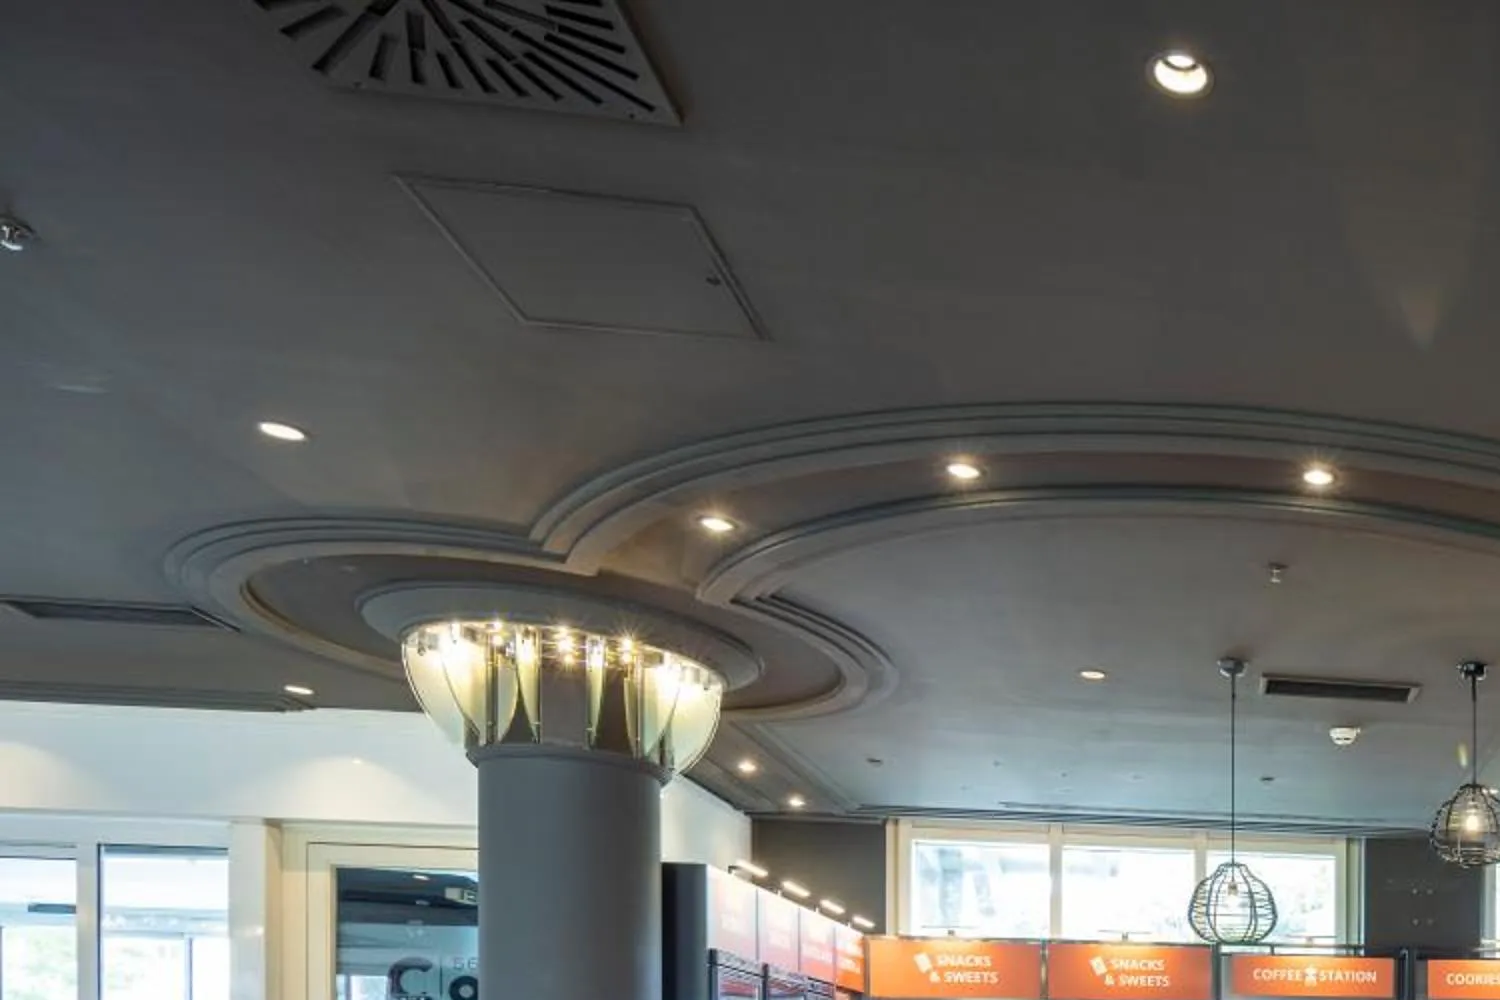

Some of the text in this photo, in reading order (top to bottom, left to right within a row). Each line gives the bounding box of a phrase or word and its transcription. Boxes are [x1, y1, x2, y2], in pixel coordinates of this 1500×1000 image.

[936, 954, 992, 967] SNACKS
[1110, 959, 1165, 971] SNACKS
[929, 971, 999, 985] & SWEETS
[1104, 974, 1171, 988] & SWEETS
[1252, 967, 1377, 983] COFFEE STATION
